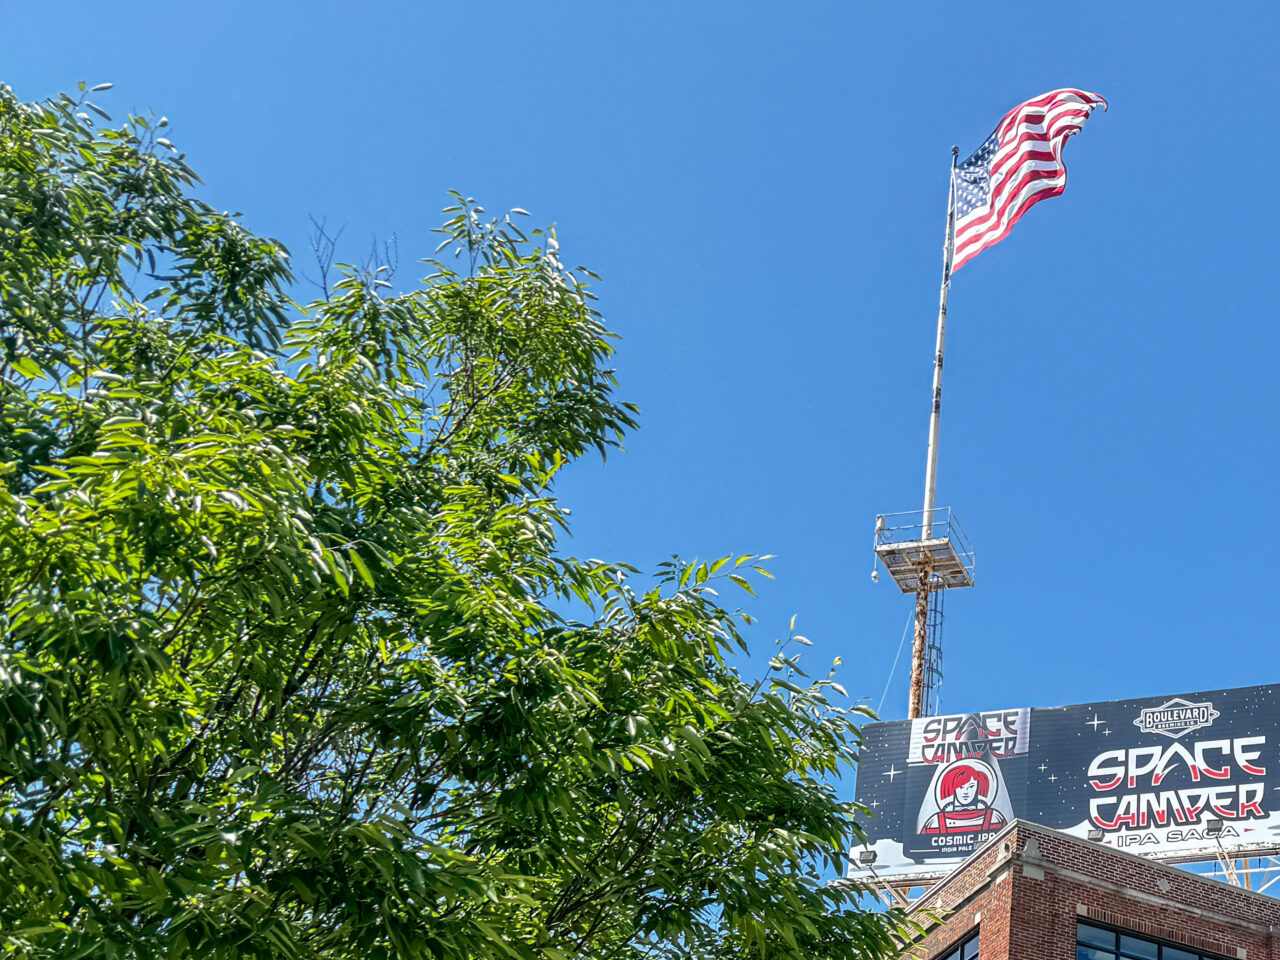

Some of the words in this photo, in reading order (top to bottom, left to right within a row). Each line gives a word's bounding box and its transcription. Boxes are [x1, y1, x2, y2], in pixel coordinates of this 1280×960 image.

[922, 711, 1019, 743] SPACE
[1146, 707, 1208, 728] BOULEVARD
[921, 737, 1017, 765] CAMPER
[1087, 736, 1266, 792] SPACE
[1089, 782, 1266, 829] CAMPER
[931, 834, 975, 847] COSMIC
[1117, 833, 1160, 848] IPA
[1166, 825, 1240, 843] SAGA
